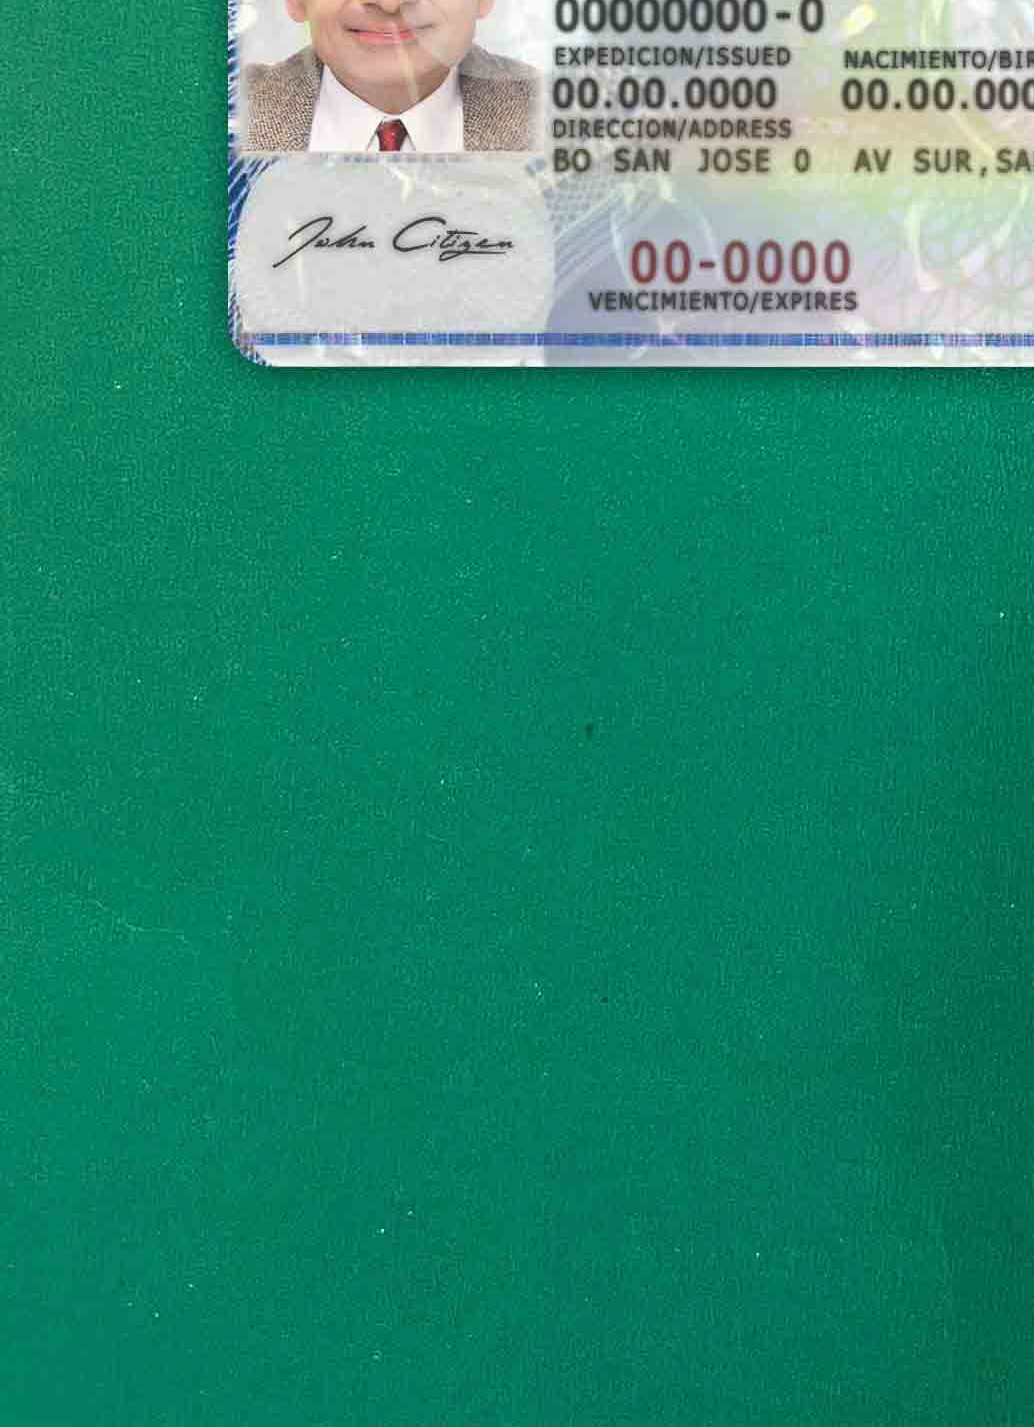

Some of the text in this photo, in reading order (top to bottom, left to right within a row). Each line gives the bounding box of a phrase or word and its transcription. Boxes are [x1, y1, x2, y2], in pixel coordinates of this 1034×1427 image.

[554, 44, 793, 68] EXPEDICION/ISSUED
[552, 77, 778, 111] 00.00.0000
[552, 118, 793, 141] DIRECCION/ADDRESS
[552, 149, 593, 173] BO
[613, 148, 671, 173] SAN
[697, 148, 772, 173] JOSE
[854, 149, 892, 173] AV
[630, 240, 852, 286] 00-0000
[588, 290, 859, 315] VENCIMIENTO/EXPIRES
